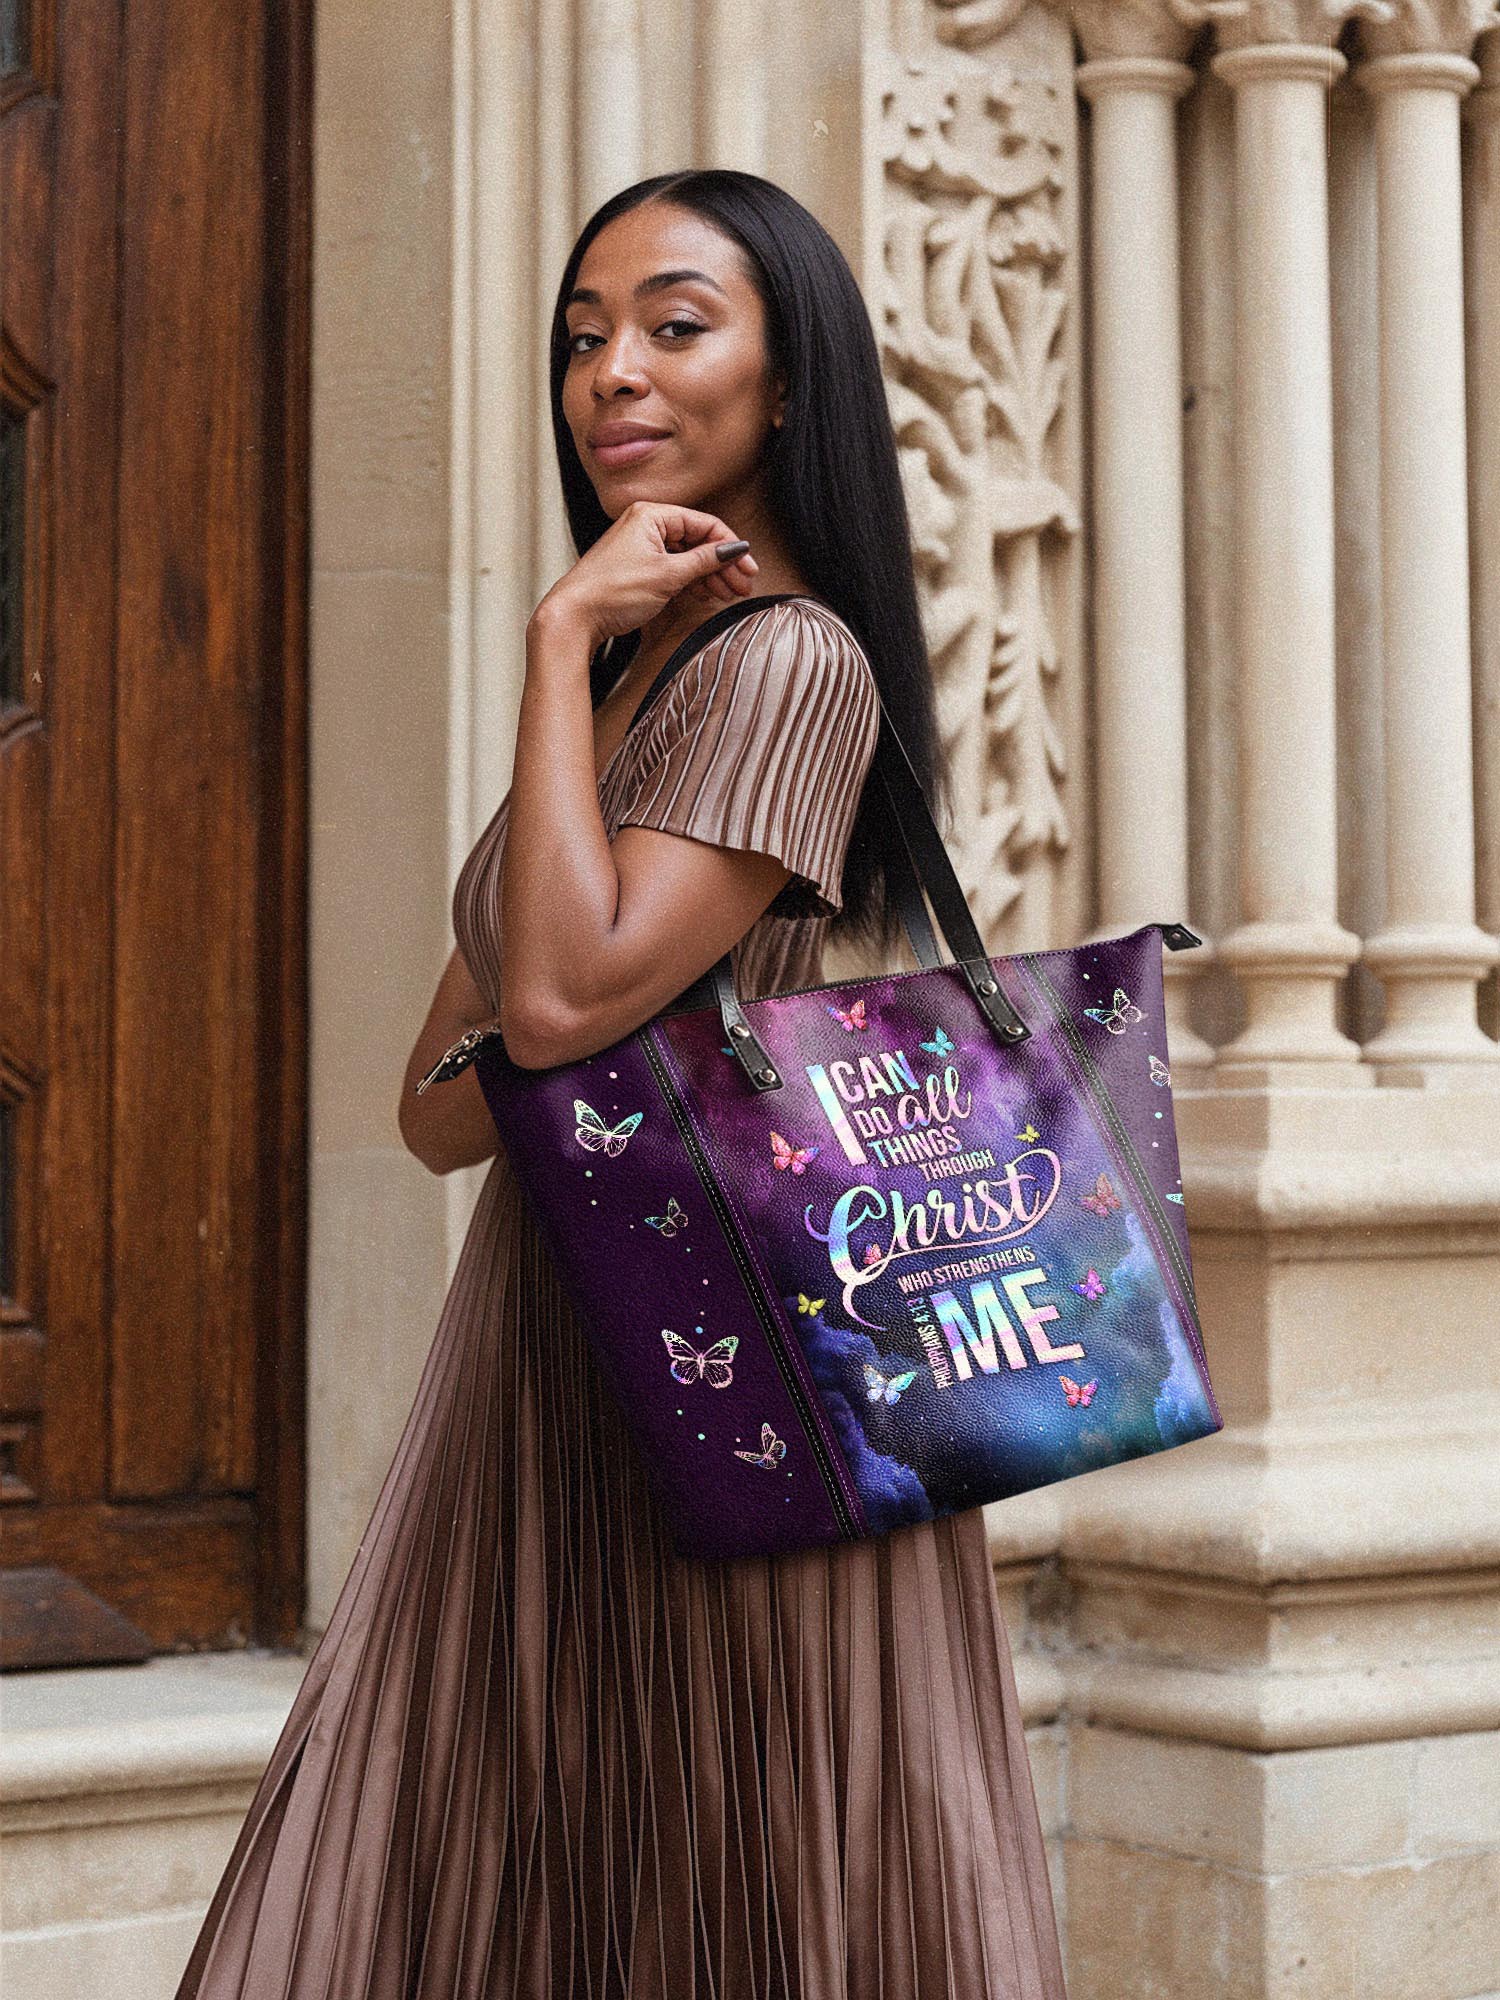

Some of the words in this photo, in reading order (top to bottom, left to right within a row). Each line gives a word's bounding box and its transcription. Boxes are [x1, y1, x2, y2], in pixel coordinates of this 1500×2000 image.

[830, 1051, 919, 1103] CAN
[853, 1106, 894, 1138] DO
[897, 1066, 971, 1130] all
[806, 1064, 868, 1166] I
[867, 1125, 962, 1167] THINGS
[918, 1149, 996, 1183] THROUGH
[804, 1149, 1061, 1330] Christ
[897, 1269, 934, 1294] WHO
[934, 1245, 1036, 1285] STRENGTHENS
[907, 1297, 930, 1322] 4:13
[930, 1267, 1085, 1382] ME
[917, 1323, 953, 1389] PHILIPPIANS
